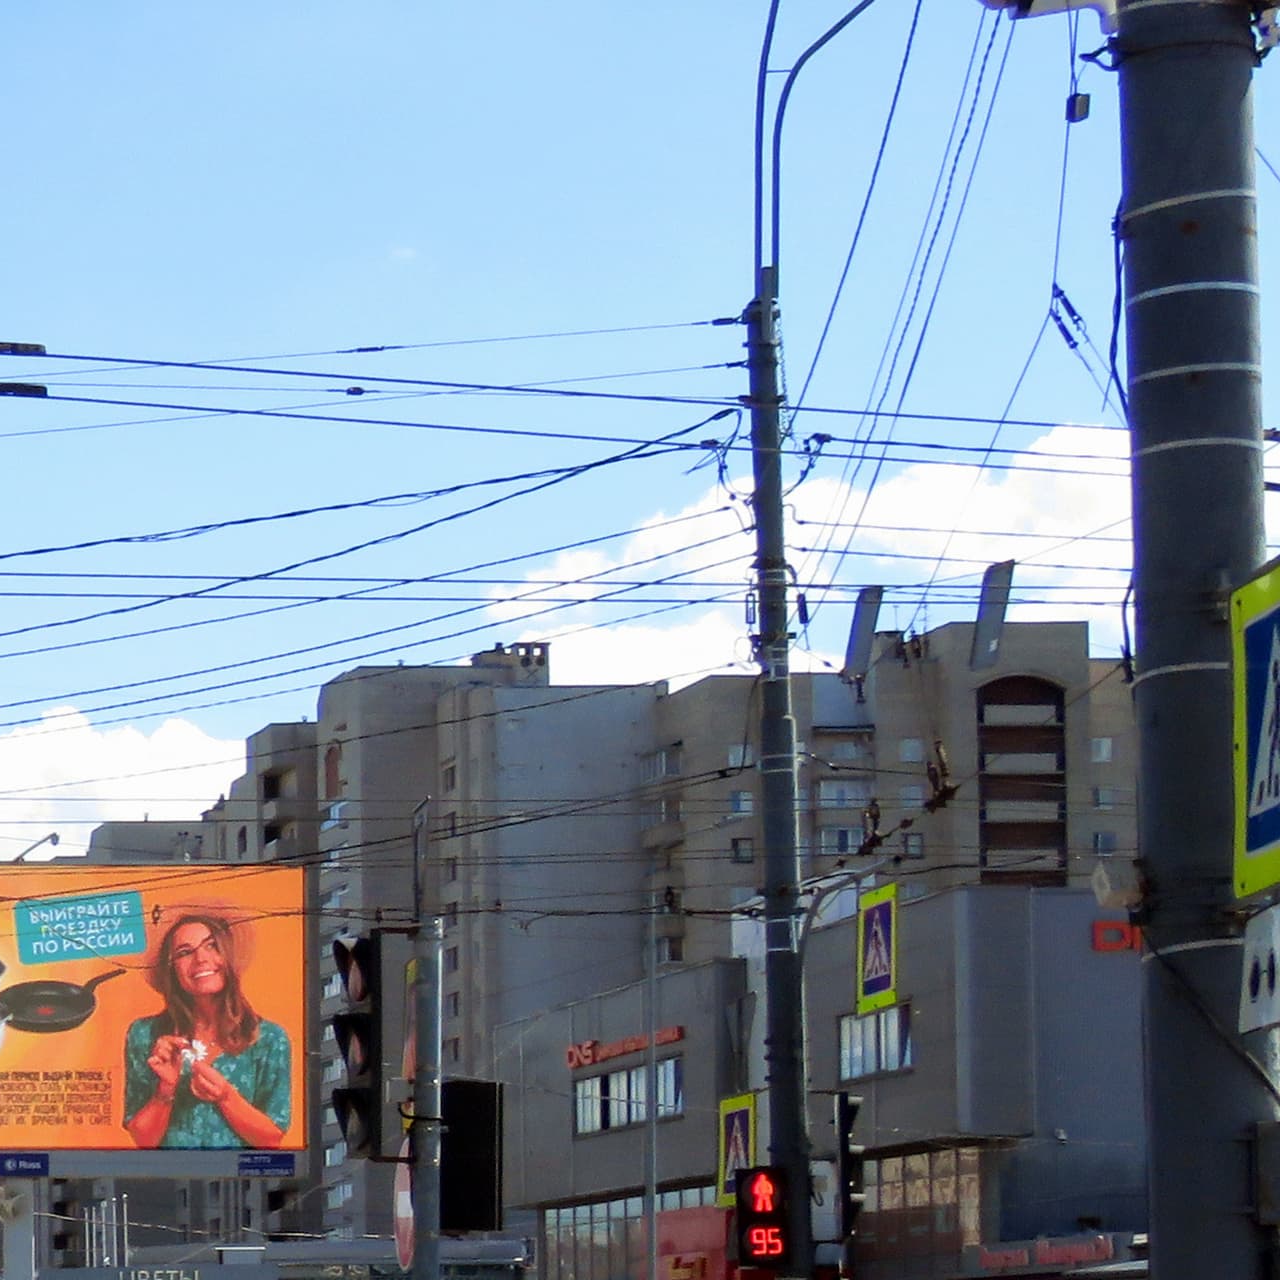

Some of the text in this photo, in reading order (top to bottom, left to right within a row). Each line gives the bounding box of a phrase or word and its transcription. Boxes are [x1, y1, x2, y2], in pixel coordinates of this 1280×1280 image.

[29, 900, 130, 924] ВЫИГРАЙТЕ
[41, 917, 122, 938] ПОЕЗДКУ
[32, 932, 135, 955] ПО РОССИИ
[751, 1228, 783, 1255] 95
